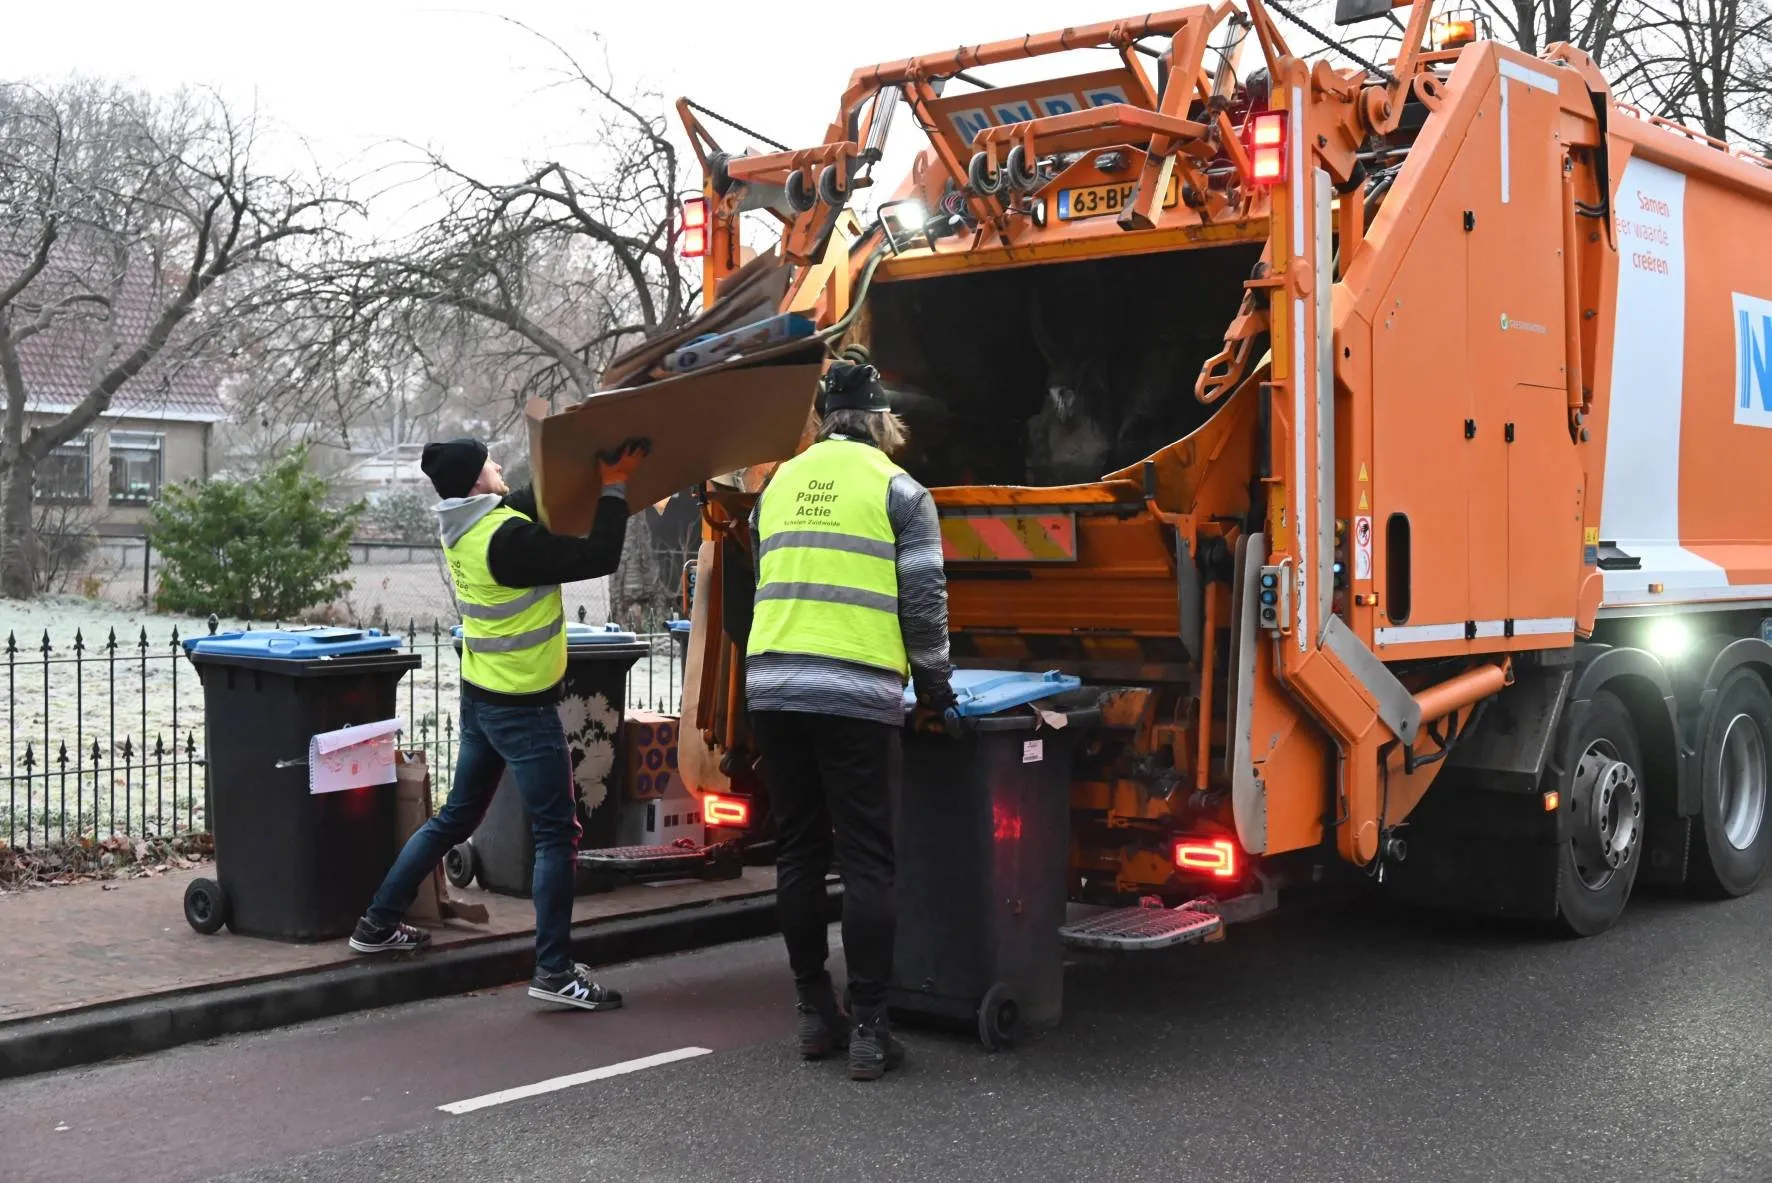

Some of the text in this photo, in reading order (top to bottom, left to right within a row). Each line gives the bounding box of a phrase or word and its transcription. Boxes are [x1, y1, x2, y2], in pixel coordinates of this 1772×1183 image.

[1073, 184, 1168, 213] 63-BH
[1637, 190, 1670, 217] Samen
[1615, 216, 1631, 235] eer
[1632, 249, 1669, 276] creëren
[808, 480, 834, 490] Oud
[796, 492, 838, 504] Papier
[796, 506, 831, 517] Actie
